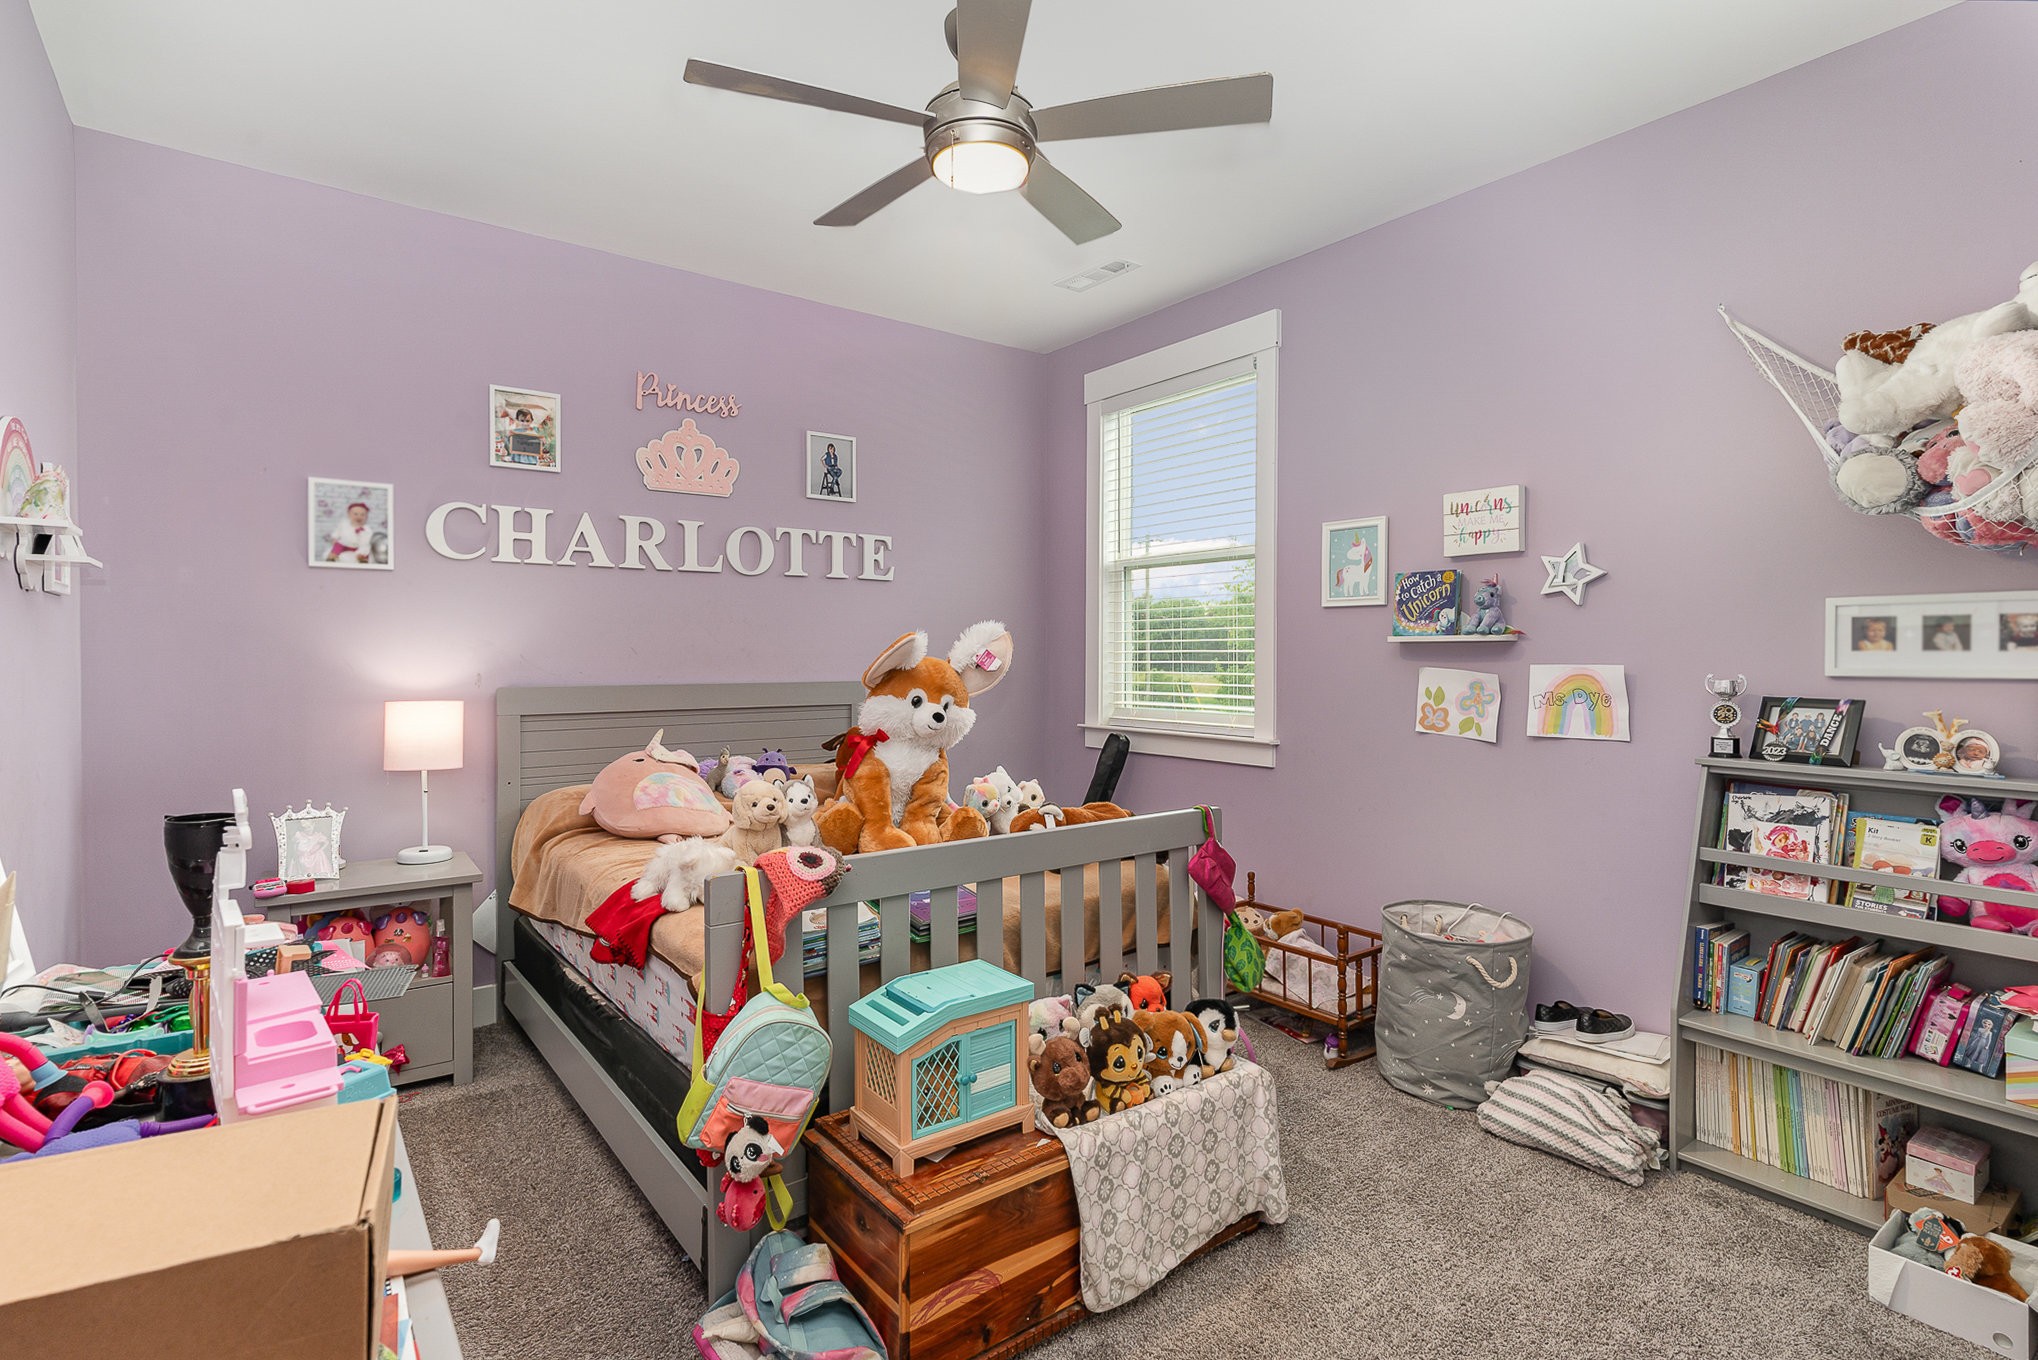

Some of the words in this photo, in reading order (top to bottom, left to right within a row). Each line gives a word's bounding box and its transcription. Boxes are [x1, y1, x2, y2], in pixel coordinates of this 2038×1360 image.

[636, 370, 742, 418] Princess
[425, 501, 896, 582] CHARLOTTE
[1401, 592, 1410, 601] to
[1410, 574, 1436, 598] Catch
[1437, 573, 1442, 582] a
[1402, 574, 1420, 589] How
[1401, 583, 1451, 621] Unicorn
[1572, 687, 1612, 711] Dye
[1820, 714, 1842, 747] DANCE
[1762, 746, 1787, 756] 2023
[1855, 900, 1888, 910] STORIES
